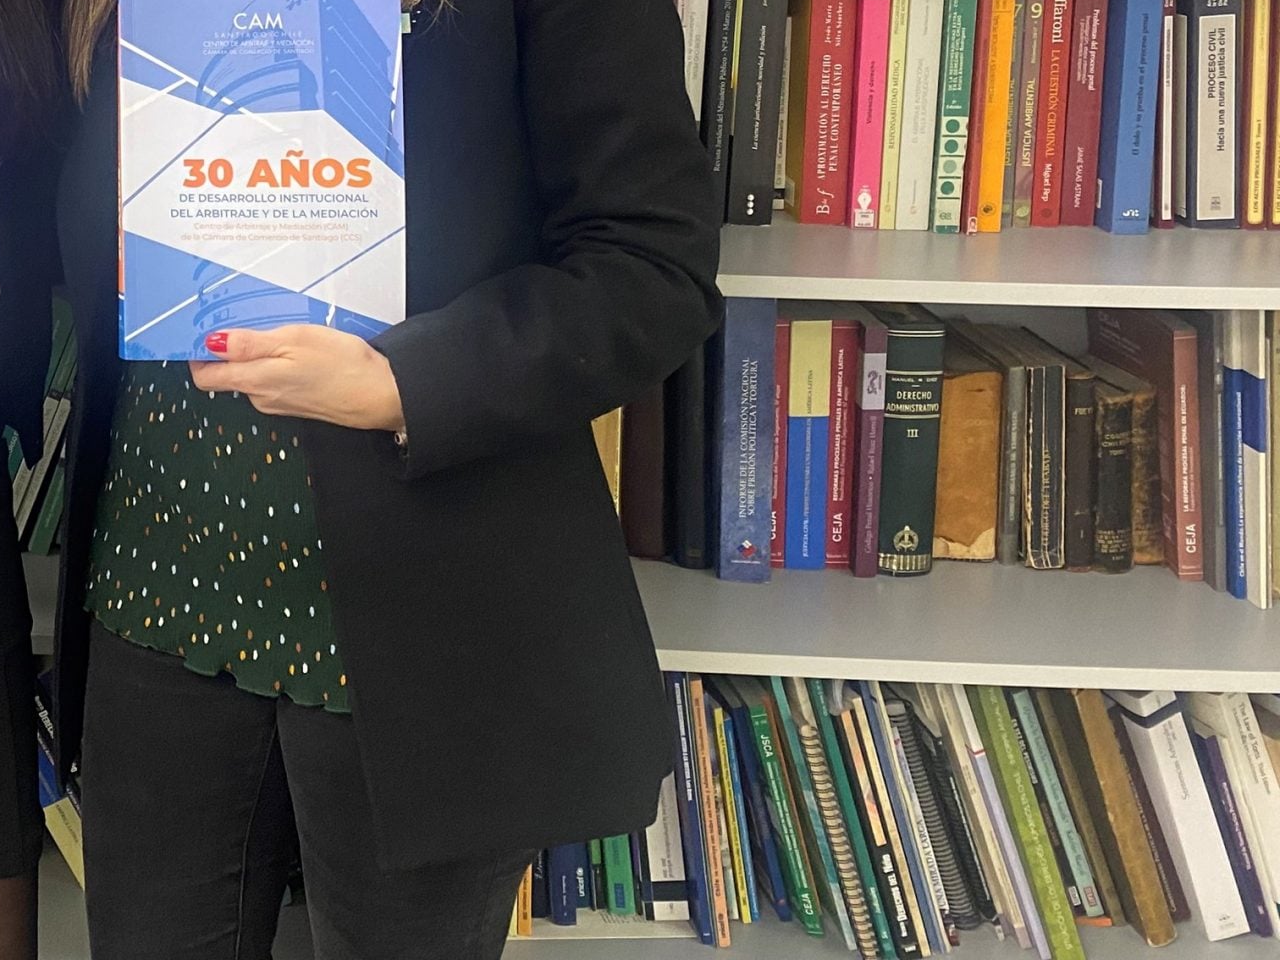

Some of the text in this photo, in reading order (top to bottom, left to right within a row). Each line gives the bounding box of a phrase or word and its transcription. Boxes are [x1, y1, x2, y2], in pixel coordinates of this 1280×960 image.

[233, 13, 283, 29] CAM
[1217, 27, 1225, 45] civil
[1207, 28, 1216, 98] PROCESO CIVIL
[1216, 47, 1227, 78] justicia
[1045, 49, 1060, 157] LA CUESTIÓN CRIMINAL
[816, 54, 831, 178] APROXIMACIÓN AL DERECHO
[828, 63, 842, 171] PENAL CONTEMPORÁNEO
[1021, 78, 1035, 166] JUSTICIA AMBIENTAL
[1216, 127, 1224, 150] Hacia
[183, 150, 373, 188] 30 AÑOS
[180, 194, 368, 203] DE DESARROLLO INSTITUCIONAL
[171, 207, 378, 218] DEL ARBITRAJE Y DE LA MEDIACIÓN
[896, 390, 931, 400] DERECHO
[886, 401, 938, 414] ADMINISTRATIVO
[906, 429, 919, 437] III
[832, 512, 842, 542] CEJA
[1185, 523, 1196, 553] CEJA
[760, 733, 773, 757] JSCA
[576, 876, 585, 896] unicef
[801, 892, 813, 916] CEJA
